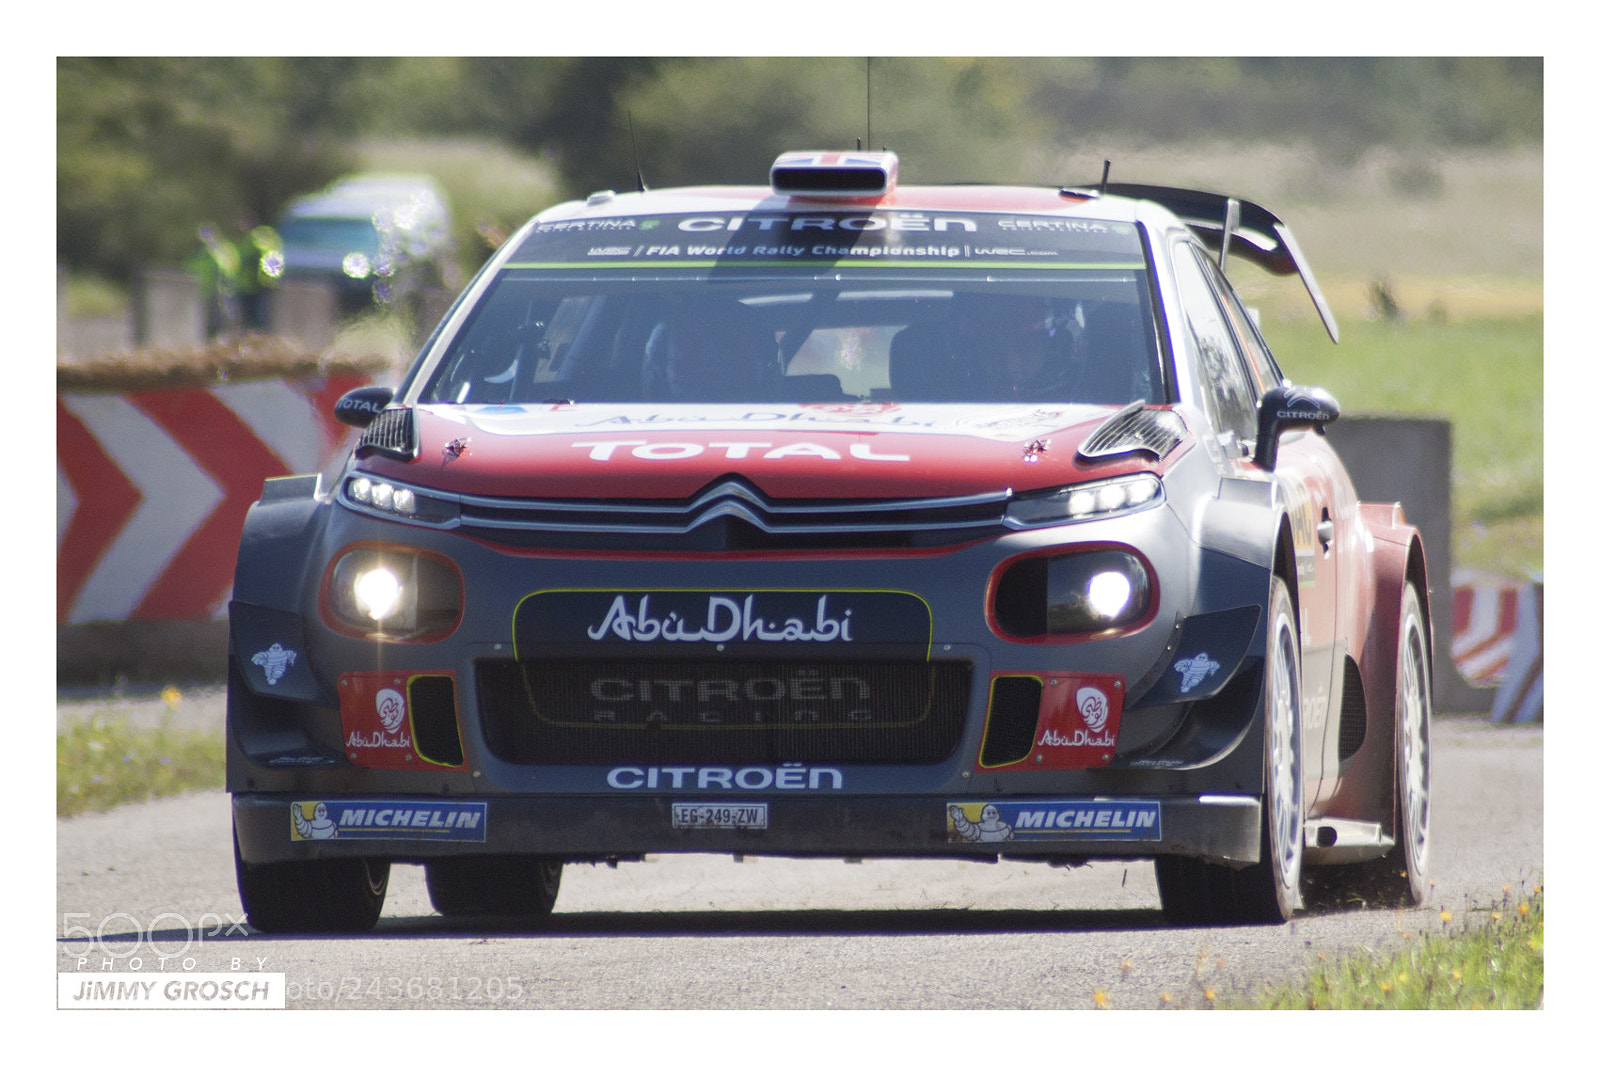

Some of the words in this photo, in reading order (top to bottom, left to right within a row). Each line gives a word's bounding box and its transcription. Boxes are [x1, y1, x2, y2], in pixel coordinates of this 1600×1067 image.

[646, 245, 679, 255] FIA
[687, 245, 746, 256] World
[752, 246, 804, 257] Rally
[811, 245, 960, 257] Championship
[336, 399, 380, 413] TOTAL
[571, 439, 910, 462] TOTAL
[339, 808, 481, 829] MICHELIN
[681, 808, 758, 824] EG-249-ZW
[1014, 811, 1156, 829] MICHELIN
